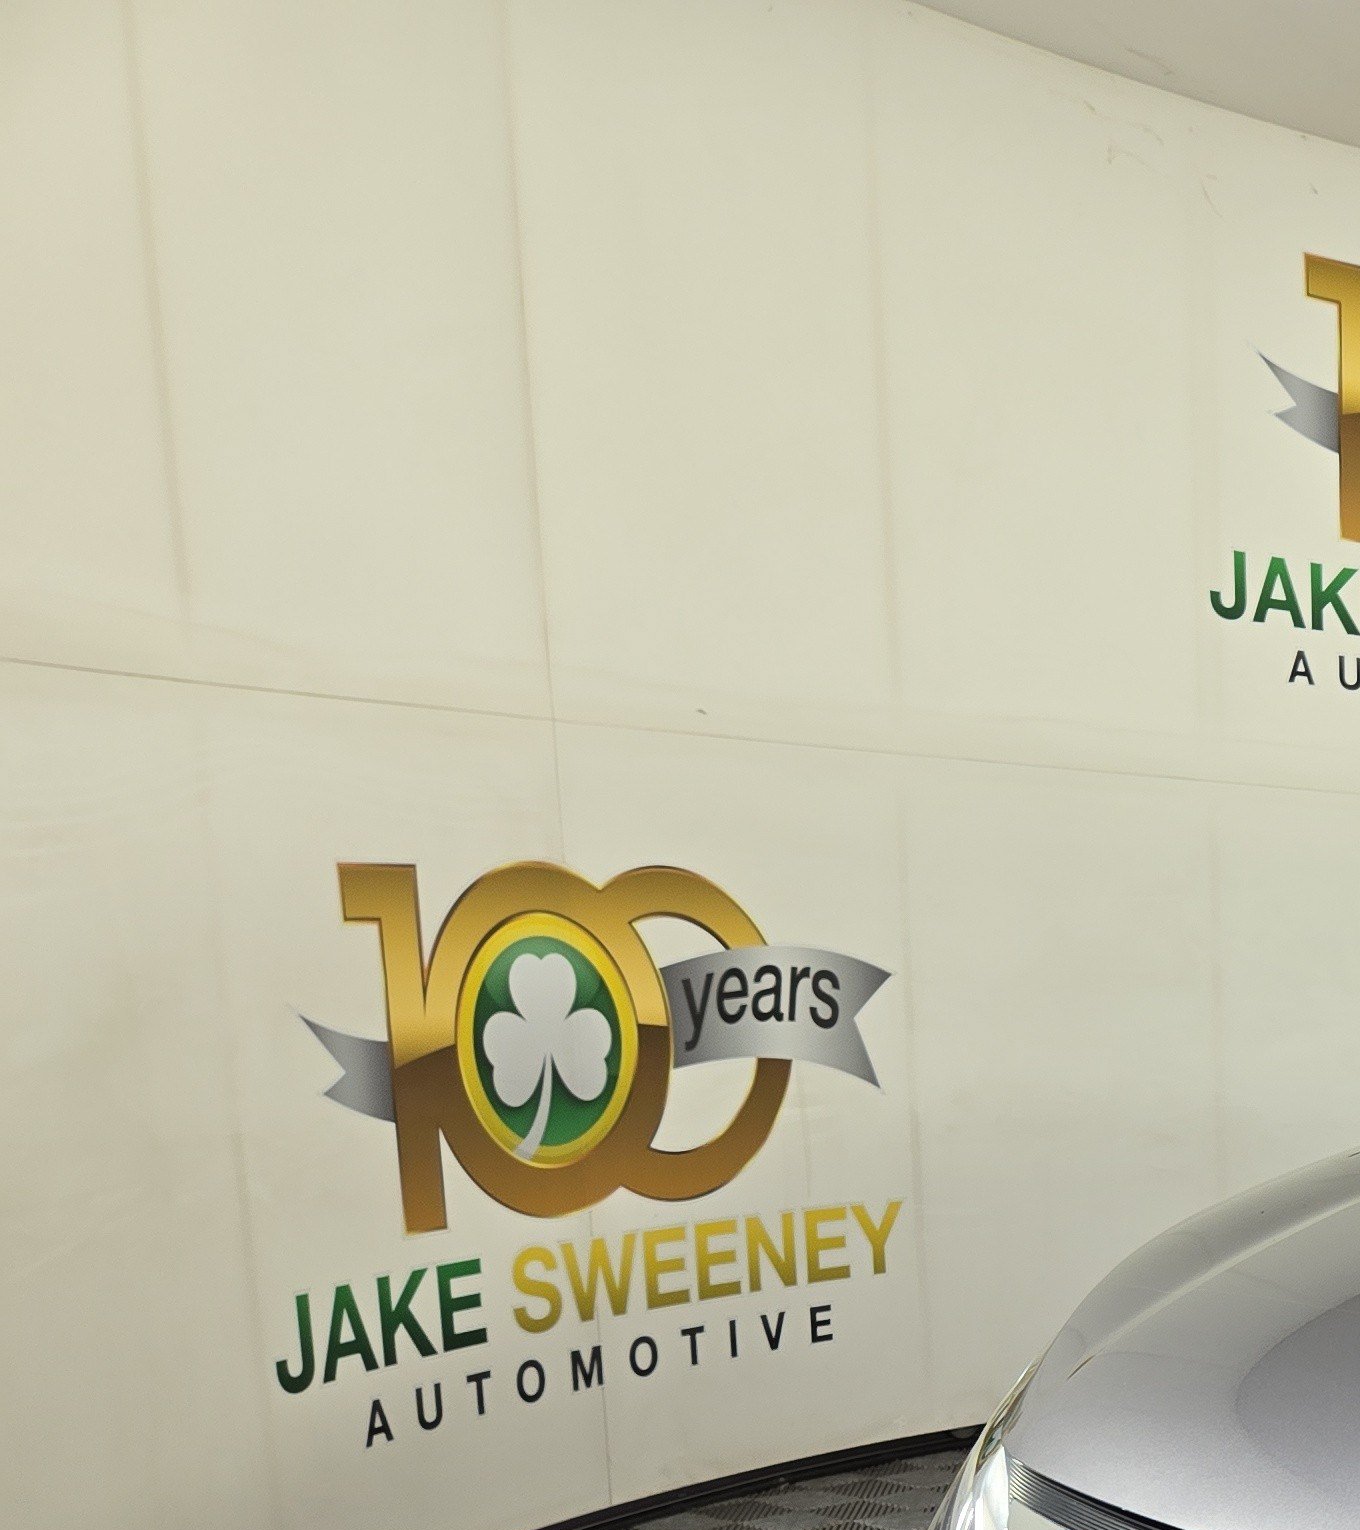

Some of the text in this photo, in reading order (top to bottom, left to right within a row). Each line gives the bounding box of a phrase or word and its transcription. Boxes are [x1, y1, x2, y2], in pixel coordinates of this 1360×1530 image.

[681, 962, 840, 1052] years
[274, 1200, 903, 1396] JAKE SWEENEY
[364, 1303, 834, 1449] AUTOMOTIVE
